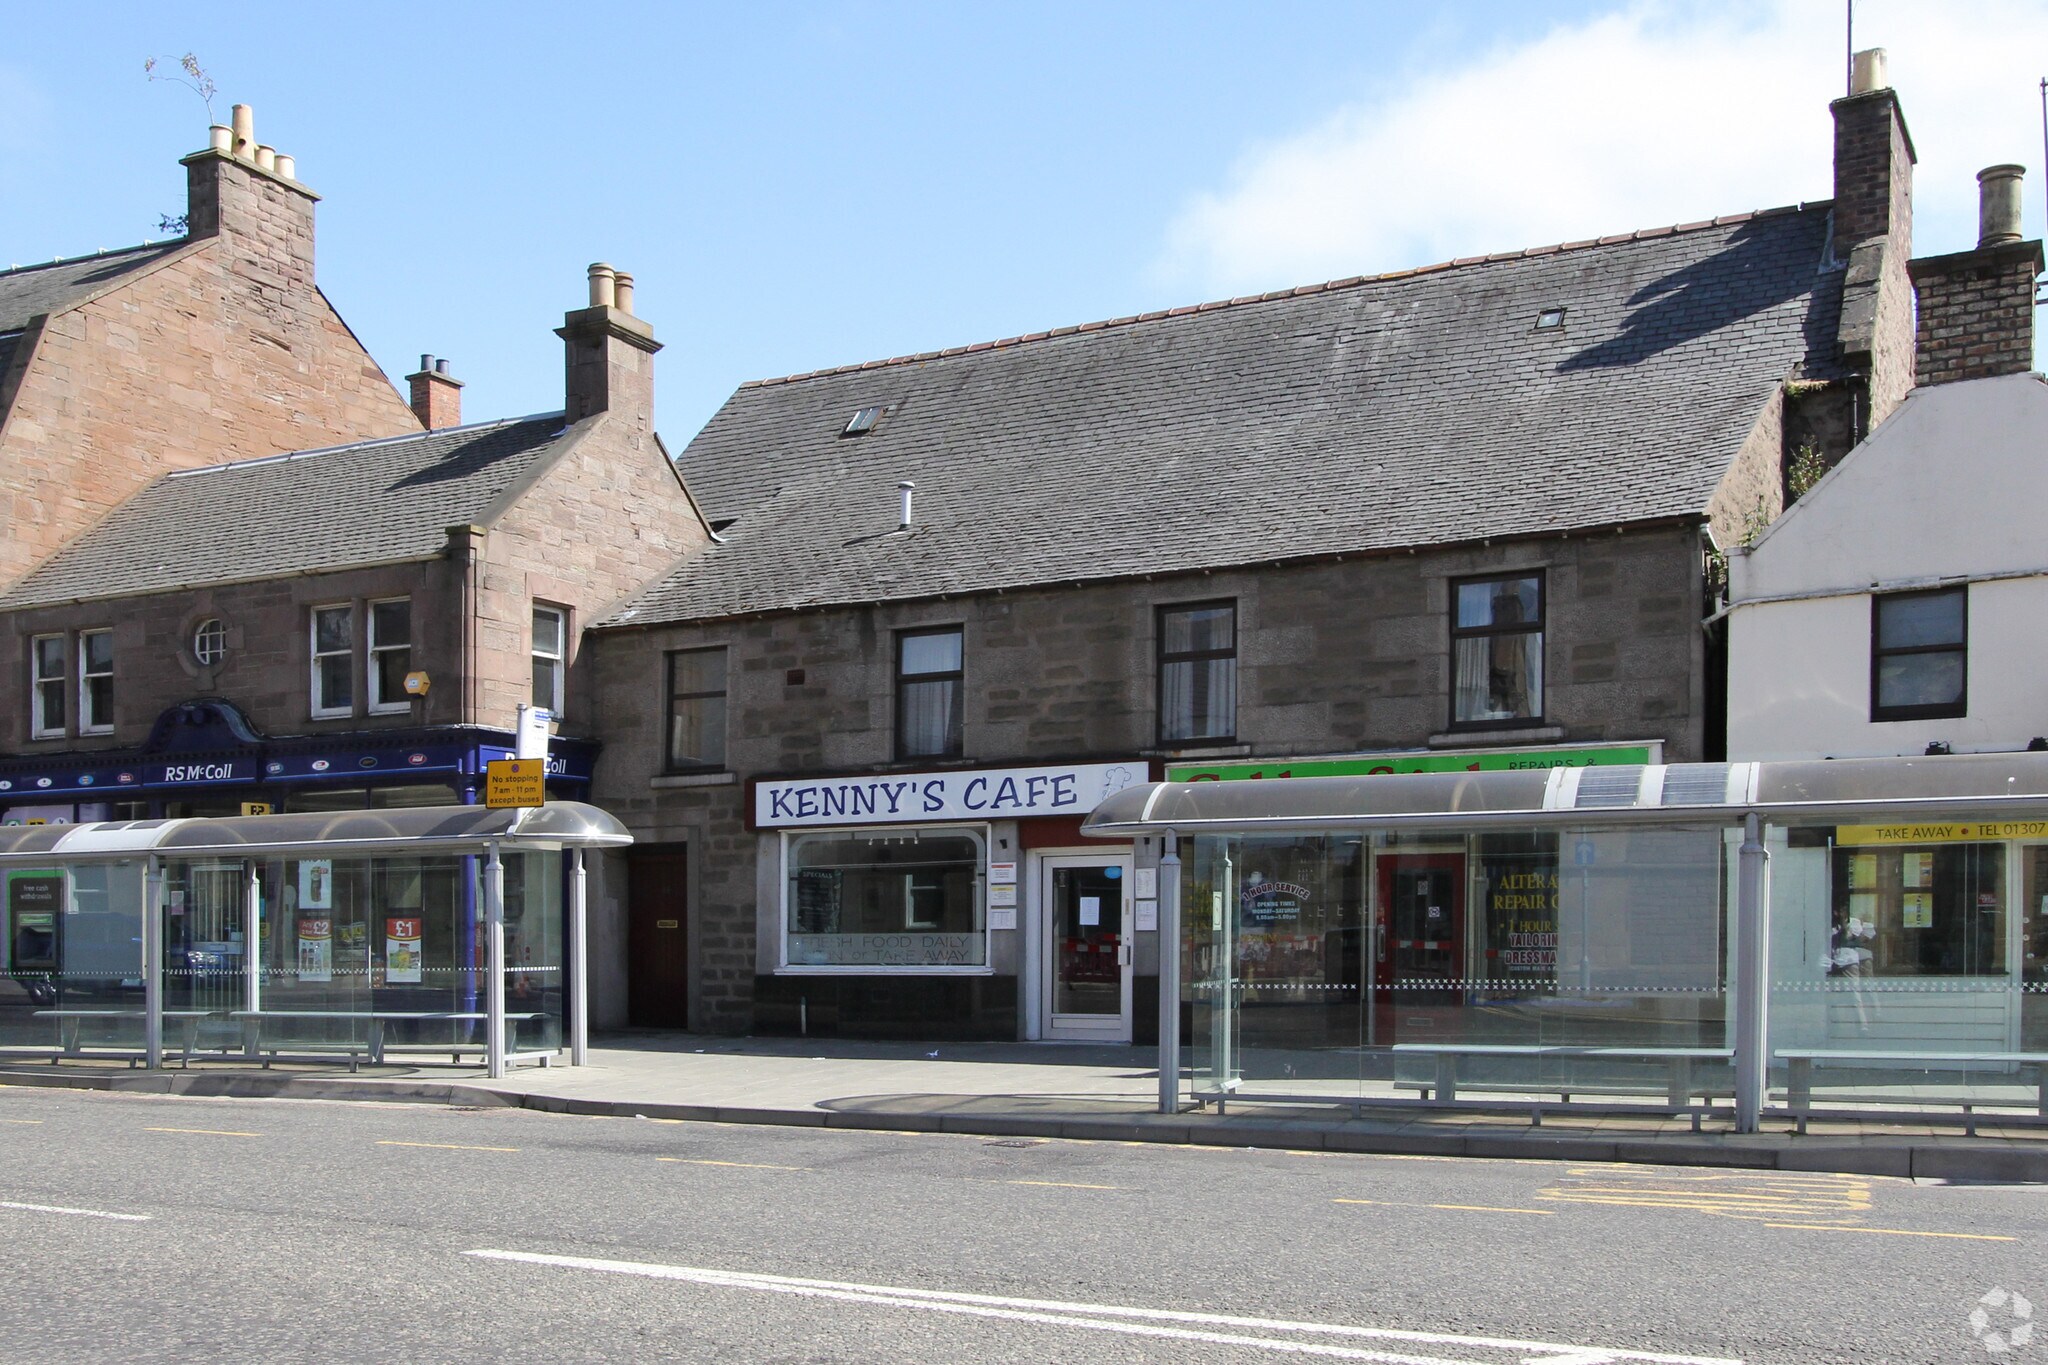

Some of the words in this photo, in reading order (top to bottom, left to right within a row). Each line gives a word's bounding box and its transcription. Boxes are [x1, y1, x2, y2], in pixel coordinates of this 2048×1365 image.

[165, 766, 185, 781] RS
[505, 775, 538, 783] stopping
[490, 796, 516, 804] except
[518, 795, 539, 803] buses
[770, 780, 945, 818] KENNY'S
[963, 774, 1077, 810] CAFE
[1876, 828, 1909, 840] TAKE
[1912, 826, 1954, 838] AWAY
[1978, 825, 2000, 836] TEL
[2003, 822, 2046, 835] 01307
[1249, 883, 1274, 899] HOUR
[1274, 882, 1311, 900] SERVICE
[1494, 895, 1546, 909] REPAIR
[313, 921, 329, 935] £2
[396, 921, 412, 936] £1
[1520, 920, 1552, 931] HOUR
[863, 936, 912, 948] FOOD
[922, 936, 969, 948] DAILY
[873, 950, 915, 961] TAKE
[923, 950, 969, 961] AWAY
